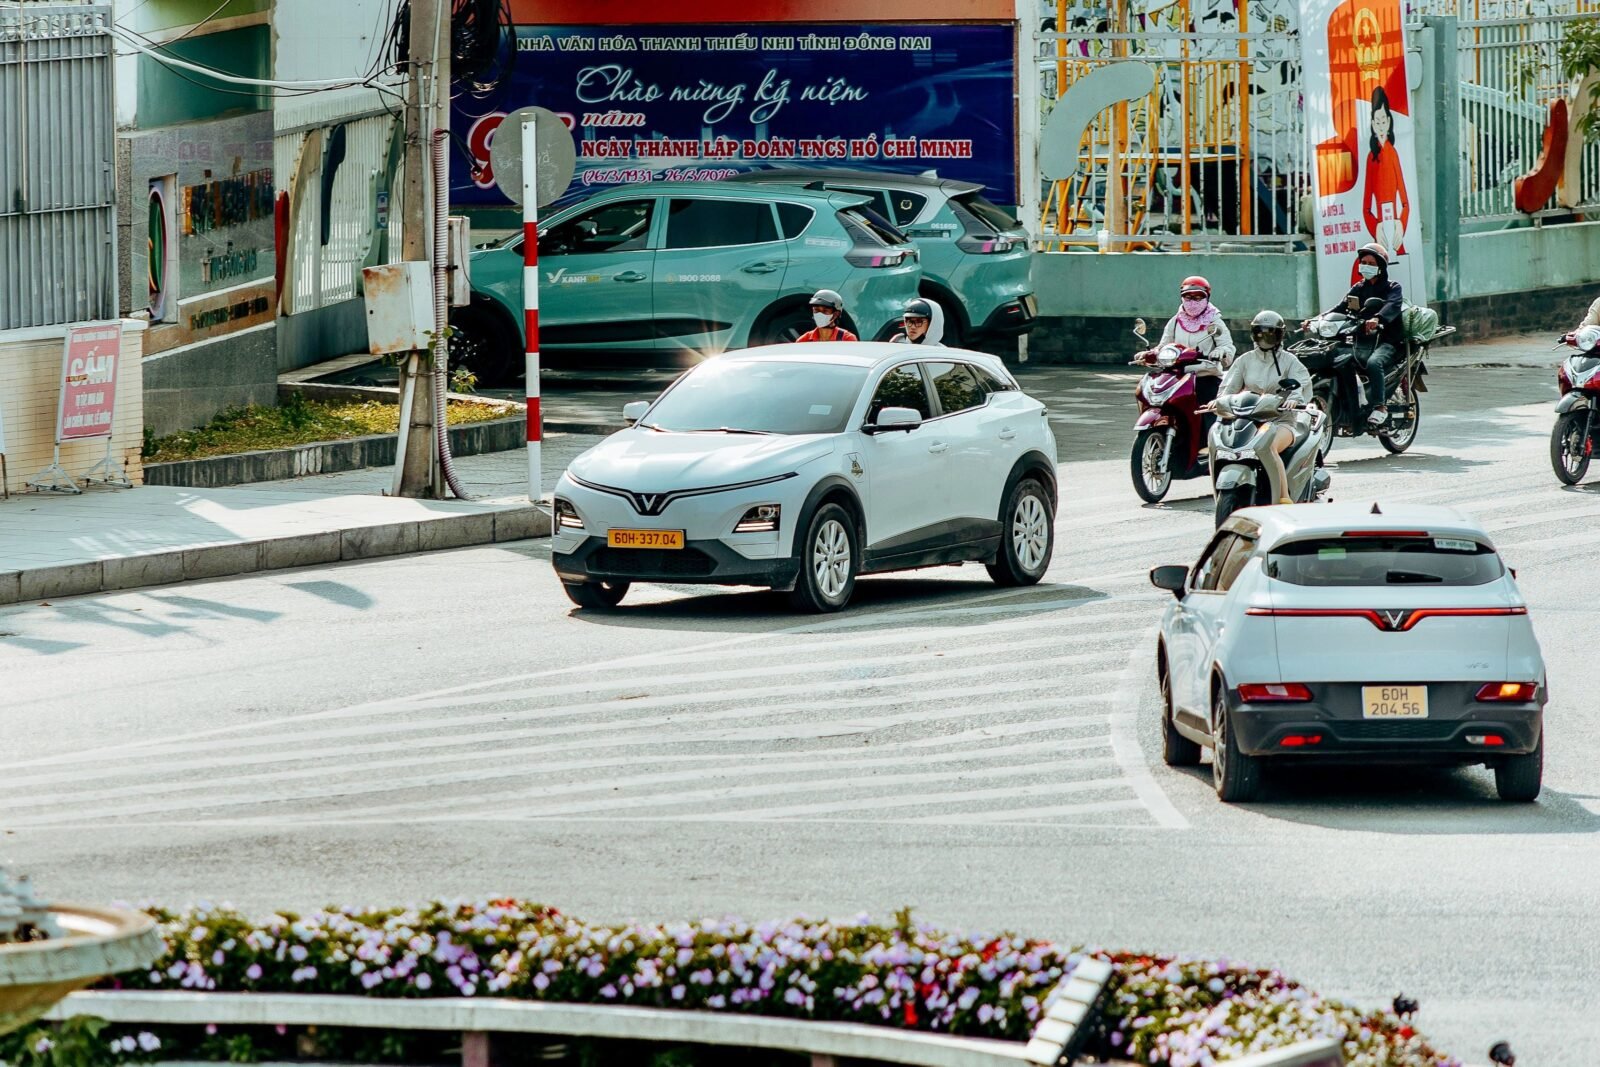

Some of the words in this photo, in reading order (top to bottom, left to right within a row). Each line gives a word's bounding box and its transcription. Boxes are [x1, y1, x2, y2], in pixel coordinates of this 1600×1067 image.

[517, 35, 555, 51] NHÀ
[557, 35, 594, 51] VĂN
[599, 34, 638, 51] HÓA
[640, 37, 701, 51] THANH
[705, 33, 757, 51] THIẾU
[762, 37, 794, 51] NHI
[797, 33, 840, 51] TỈNH
[843, 33, 896, 51] ĐỒNG
[900, 37, 931, 51] NAI
[576, 65, 664, 104] Chào
[669, 79, 747, 124] mừng
[749, 68, 792, 124] kỷ
[800, 77, 870, 106] niệm
[580, 109, 646, 127] năm
[581, 135, 634, 158] NGÀY
[635, 135, 700, 158] THÀNH
[702, 135, 739, 161] LẬP
[743, 135, 795, 158] ĐOÀN
[800, 139, 847, 158] TNCS
[850, 132, 879, 158] HỒ
[882, 136, 917, 158] CHÍ
[920, 139, 973, 158] MINH
[582, 168, 652, 186] (26/3/1931
[70, 346, 115, 387] CẤM
[614, 532, 677, 545] 60H-337.04
[1381, 688, 1409, 701] 60H
[1371, 702, 1420, 716] 204.56
